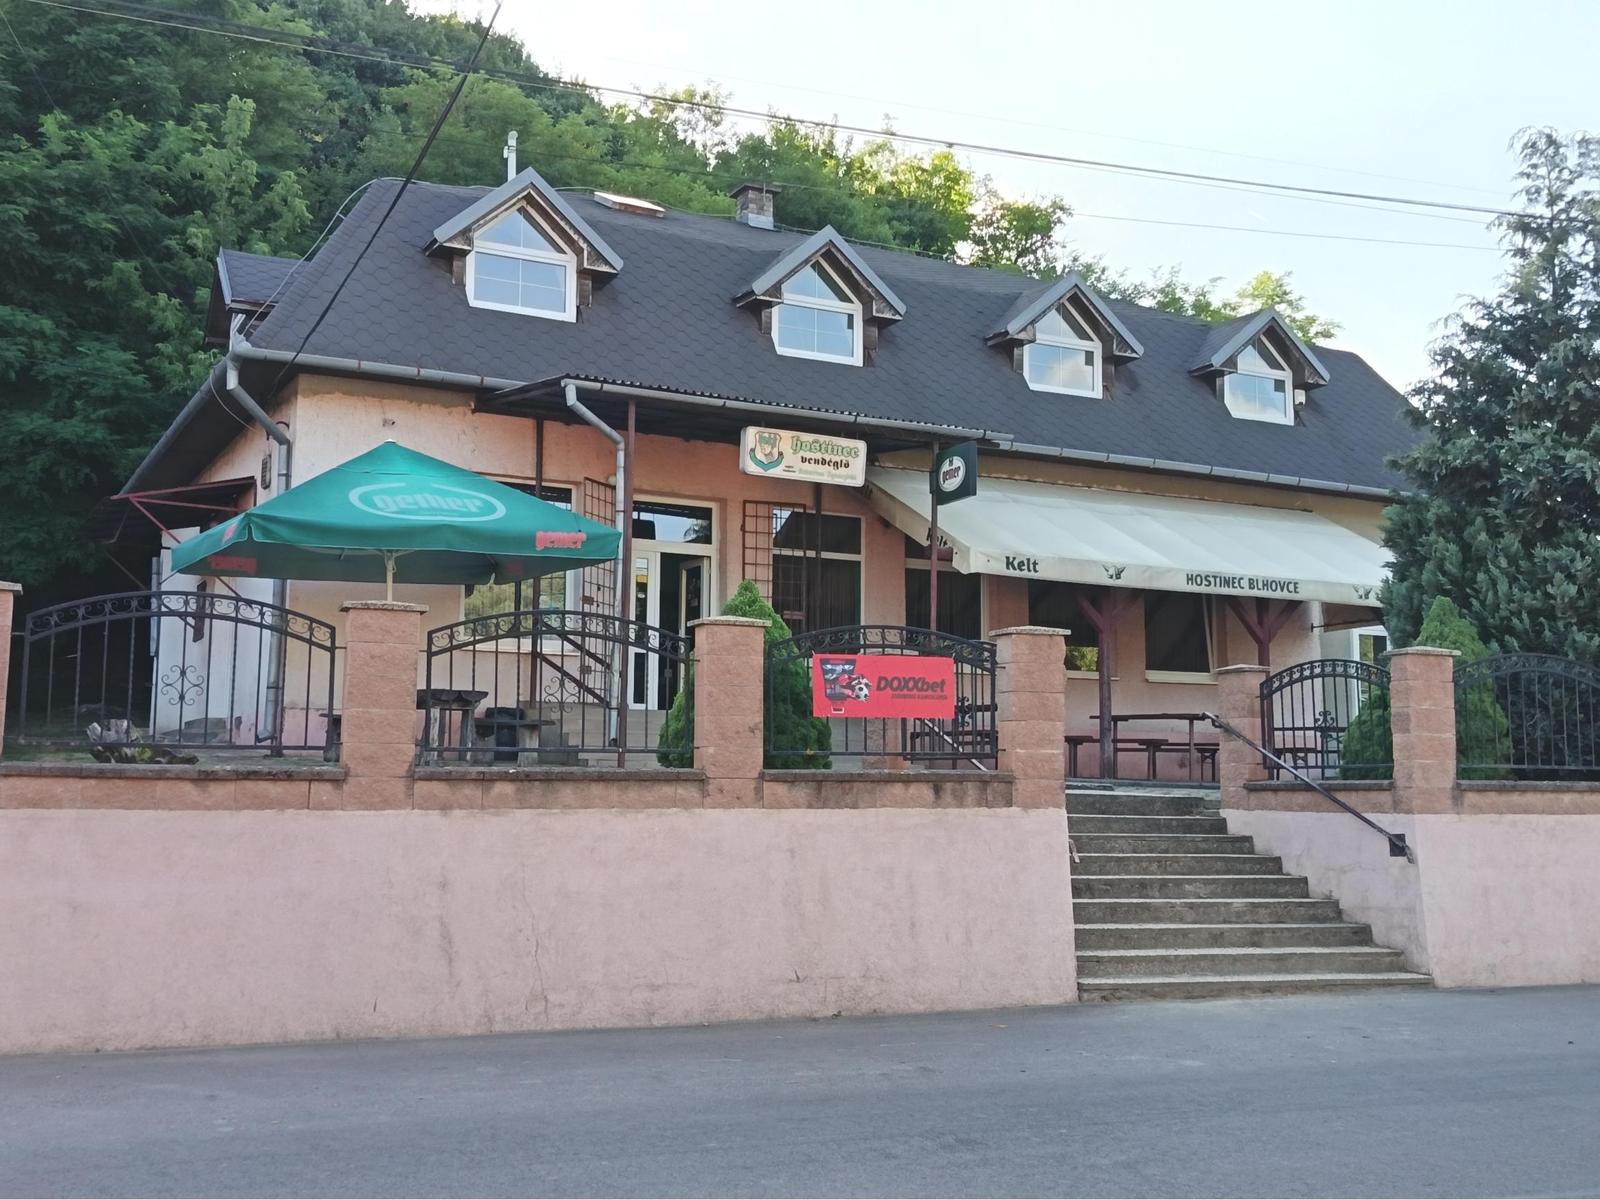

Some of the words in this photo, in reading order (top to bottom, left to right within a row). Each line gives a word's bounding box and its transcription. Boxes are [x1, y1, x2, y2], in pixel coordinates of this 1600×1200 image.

[1005, 555, 1040, 573] Kelt
[1186, 573, 1245, 590] HOSTINEC
[1248, 577, 1300, 594] BLHOVCE
[876, 675, 946, 693] DOXXbet
